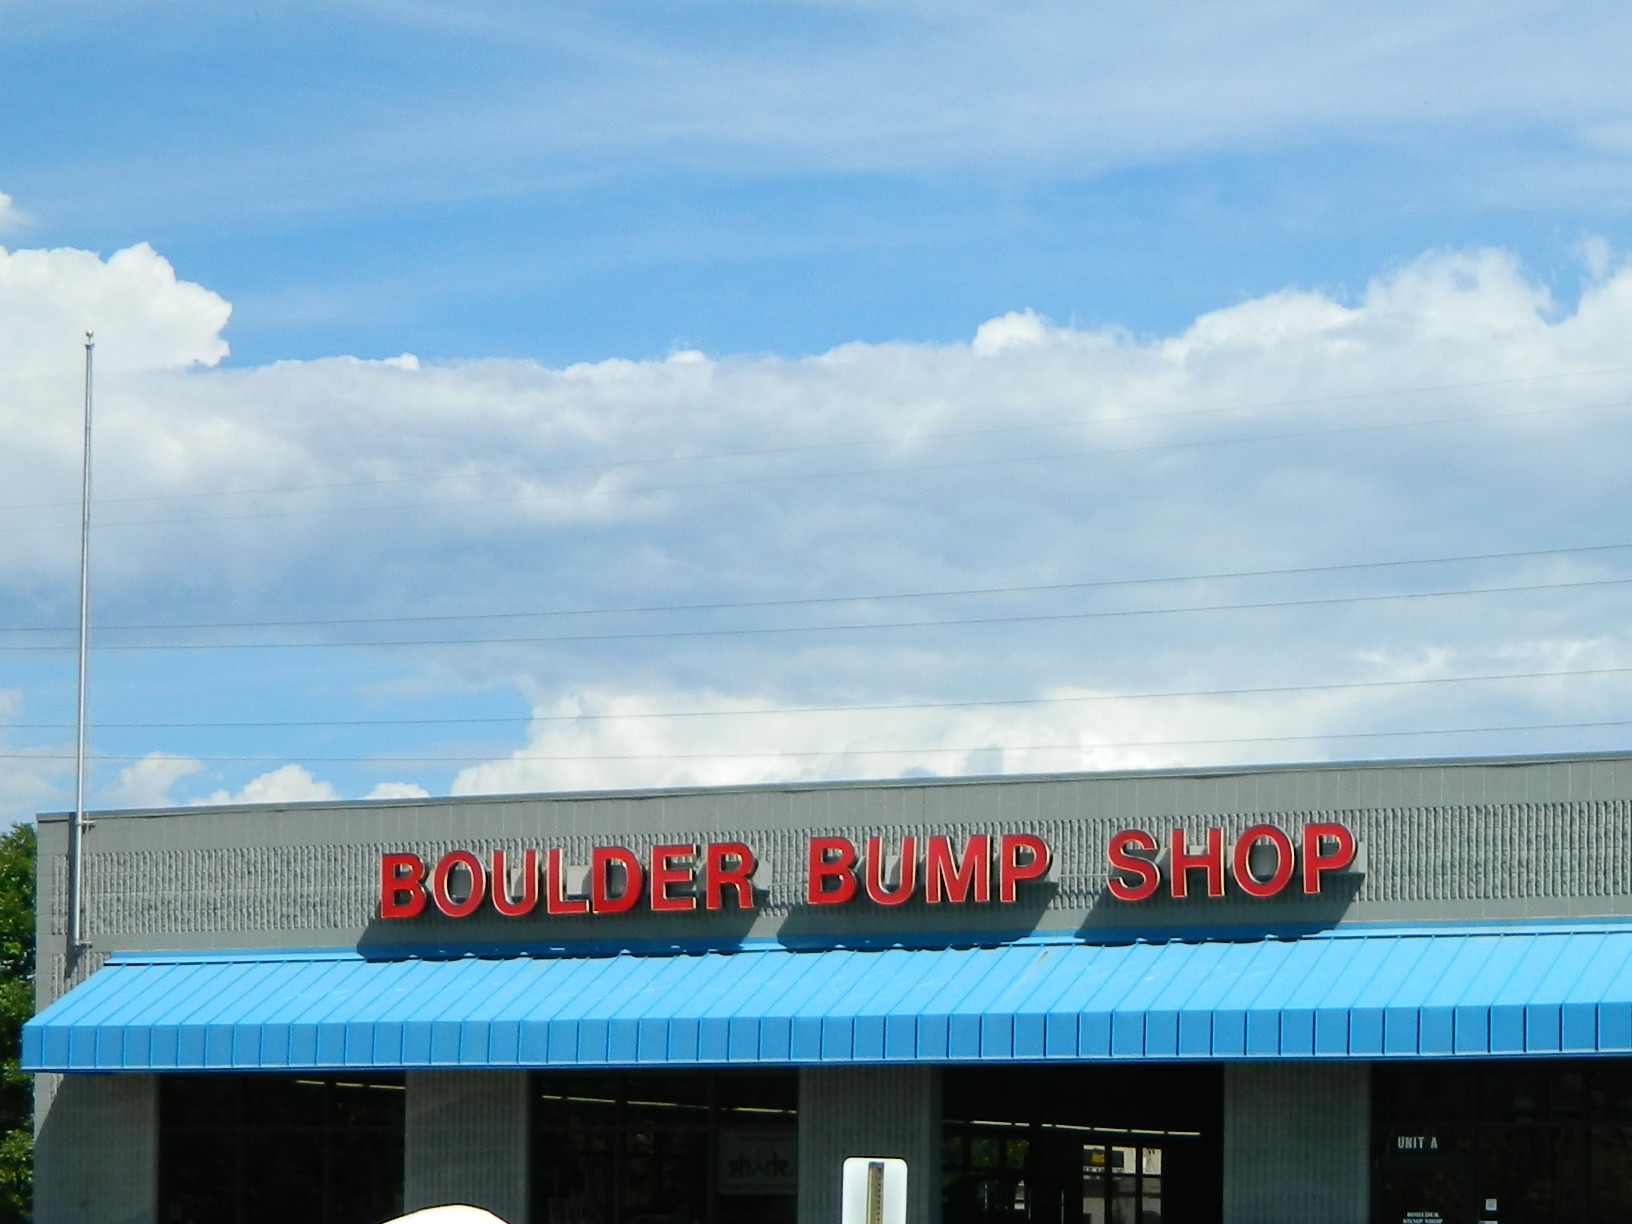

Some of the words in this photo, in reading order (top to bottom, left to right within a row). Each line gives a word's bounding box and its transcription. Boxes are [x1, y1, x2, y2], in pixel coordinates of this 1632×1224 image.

[380, 841, 756, 919] BOULDER
[806, 833, 1051, 905] BUMP
[1105, 822, 1359, 901] SHOP
[1397, 1136, 1424, 1149] UNIT
[1430, 1136, 1438, 1149] A
